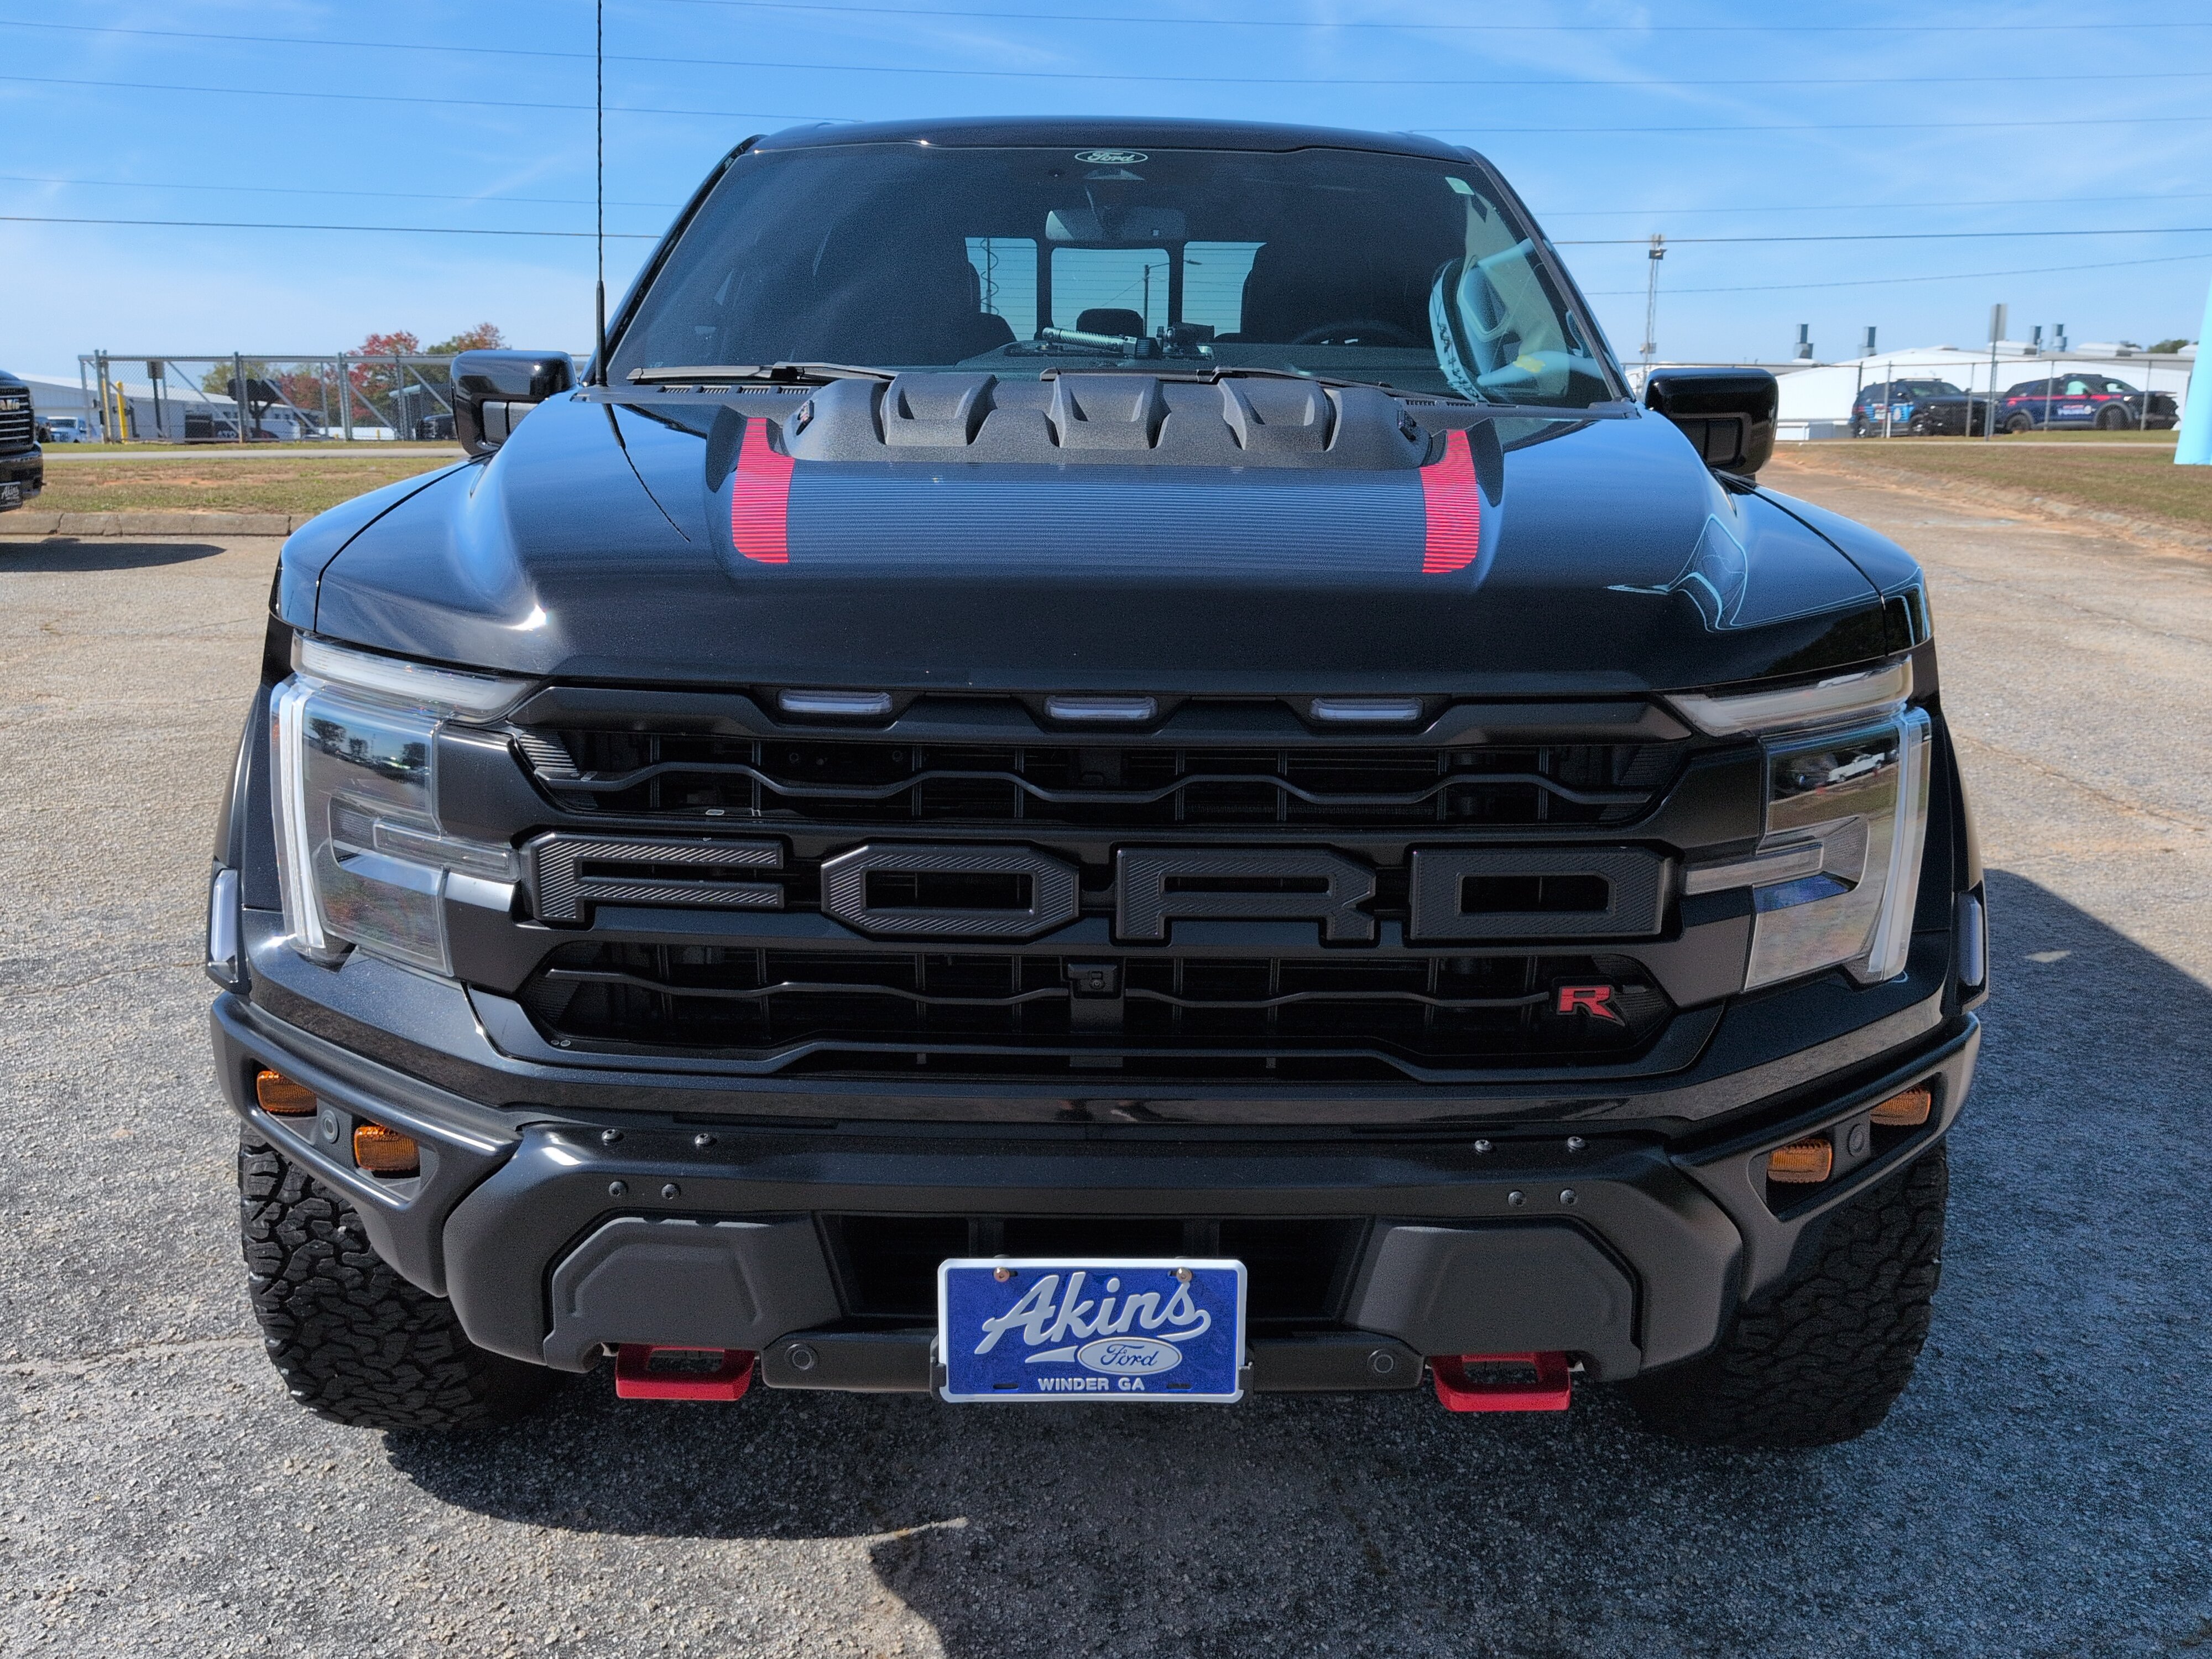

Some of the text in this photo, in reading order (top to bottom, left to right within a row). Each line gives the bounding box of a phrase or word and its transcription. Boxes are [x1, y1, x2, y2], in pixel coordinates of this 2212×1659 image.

[1087, 152, 1135, 162] Ford
[520, 831, 1676, 942] FORD
[1557, 985, 1620, 1023] R
[974, 1271, 1211, 1354] Akins
[1100, 1343, 1159, 1366] Ford
[1037, 1377, 1145, 1391] WINDER GA
